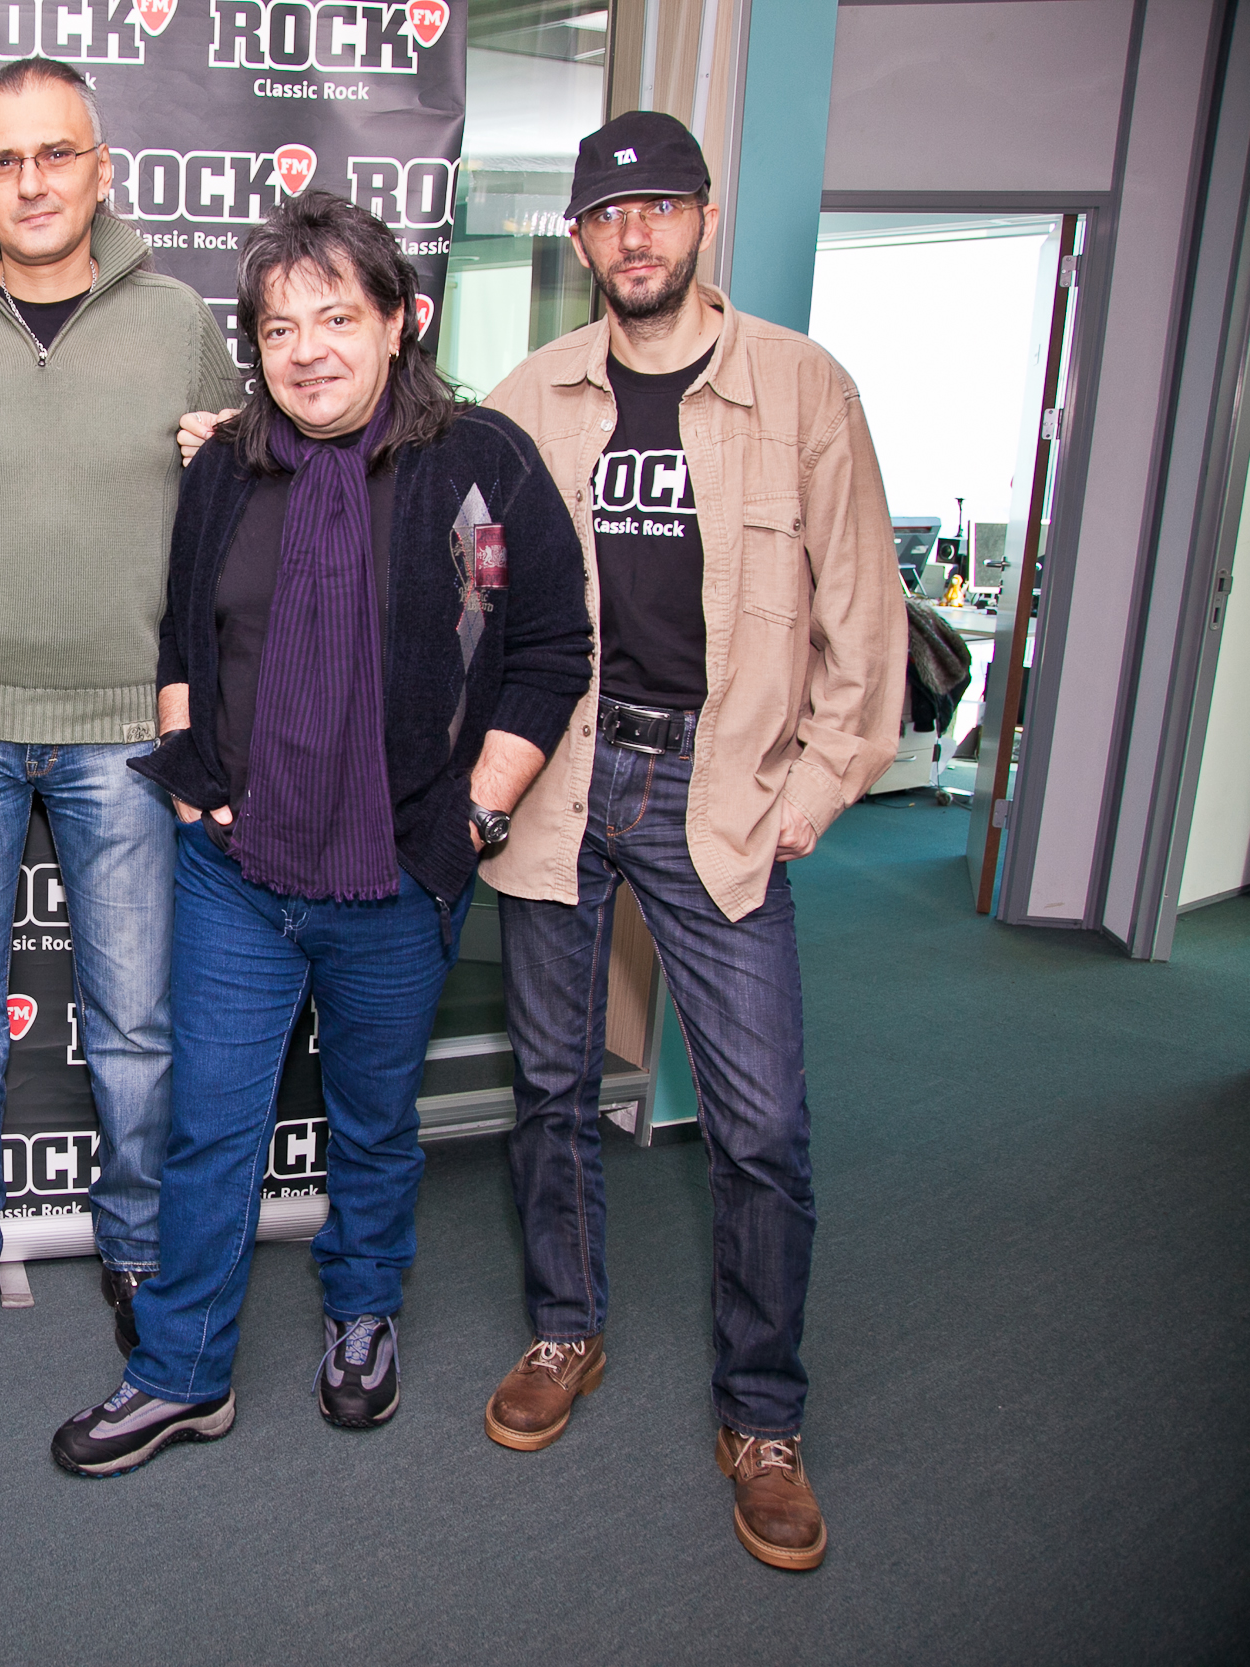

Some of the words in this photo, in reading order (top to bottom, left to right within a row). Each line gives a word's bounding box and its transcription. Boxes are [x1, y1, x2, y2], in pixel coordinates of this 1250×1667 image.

[209, 0, 418, 75] ROCK
[412, 9, 441, 26] FM
[253, 78, 318, 99] Classic
[323, 81, 370, 100] Rock
[280, 157, 309, 175] FM
[347, 156, 461, 230] RO
[136, 229, 188, 249] lassic
[193, 231, 238, 250] Rock
[394, 236, 450, 256] lassic
[642, 519, 685, 538] Rock
[42, 935, 73, 951] Roc
[0, 1131, 101, 1197] OCK
[41, 1201, 83, 1216] Rock
